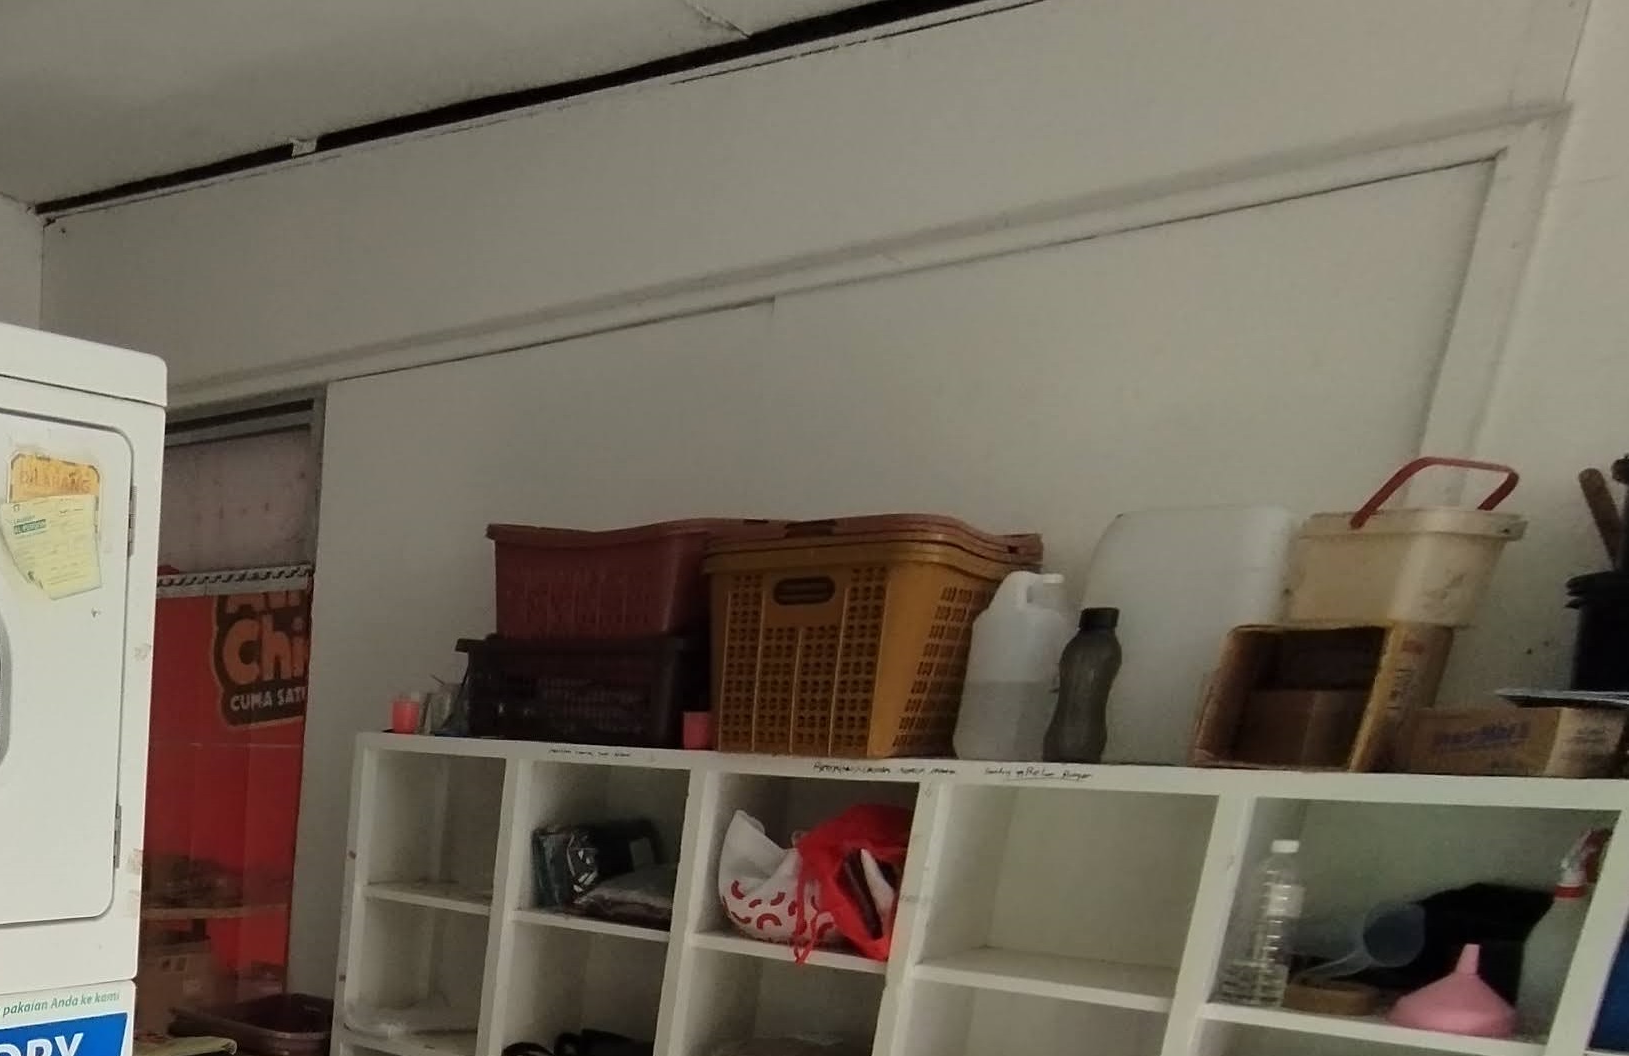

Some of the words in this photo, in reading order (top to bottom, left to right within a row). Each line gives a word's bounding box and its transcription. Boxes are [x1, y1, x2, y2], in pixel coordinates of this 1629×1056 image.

[230, 690, 273, 711] CUMA
[2, 998, 48, 1017] pakaian
[51, 995, 78, 1010] Anda
[80, 994, 92, 1006] ke
[94, 990, 120, 1003] kami
